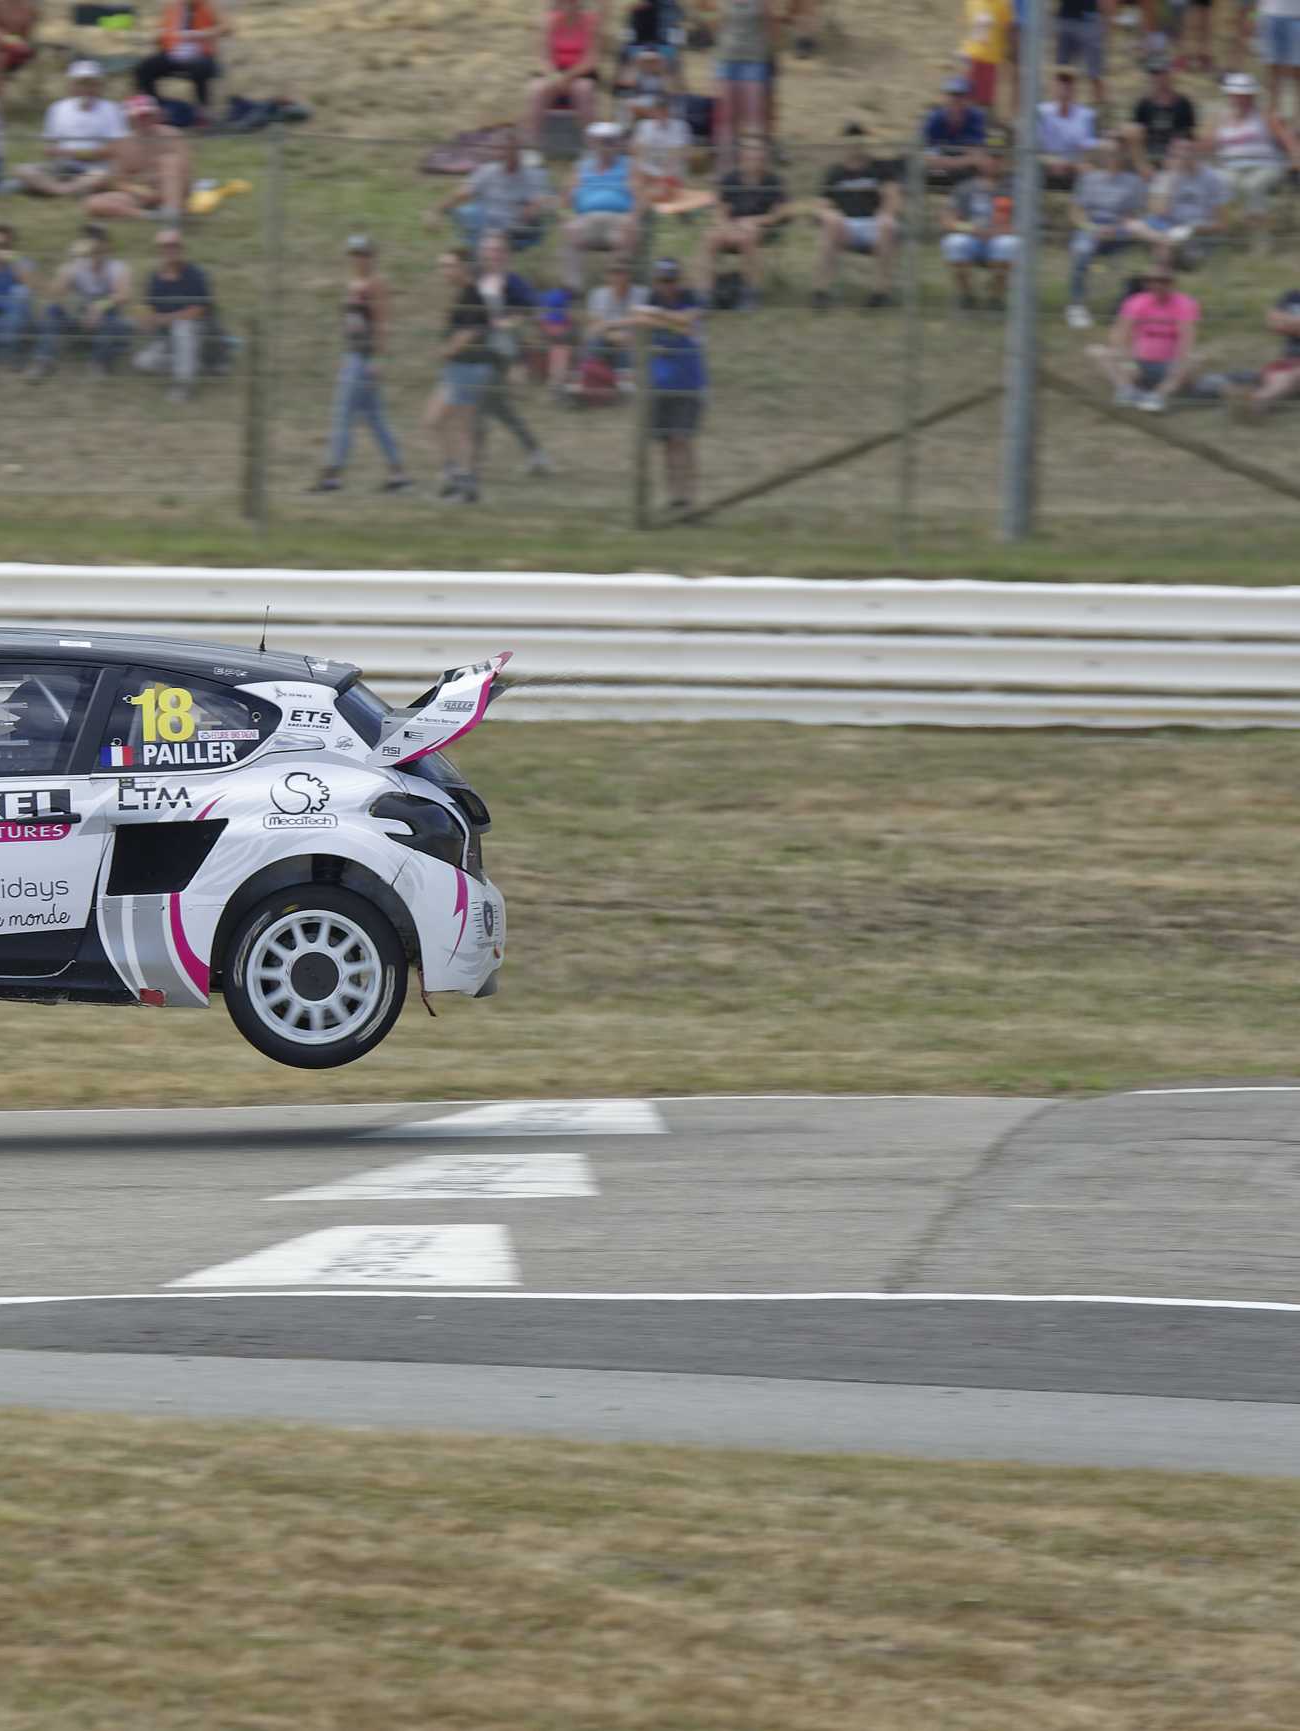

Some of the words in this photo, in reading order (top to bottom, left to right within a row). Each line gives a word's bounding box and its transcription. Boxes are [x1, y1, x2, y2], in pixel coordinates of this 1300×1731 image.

[130, 687, 195, 742] 18
[290, 709, 333, 724] ETS
[143, 742, 237, 766] PAILLER
[9, 904, 71, 927] monde
